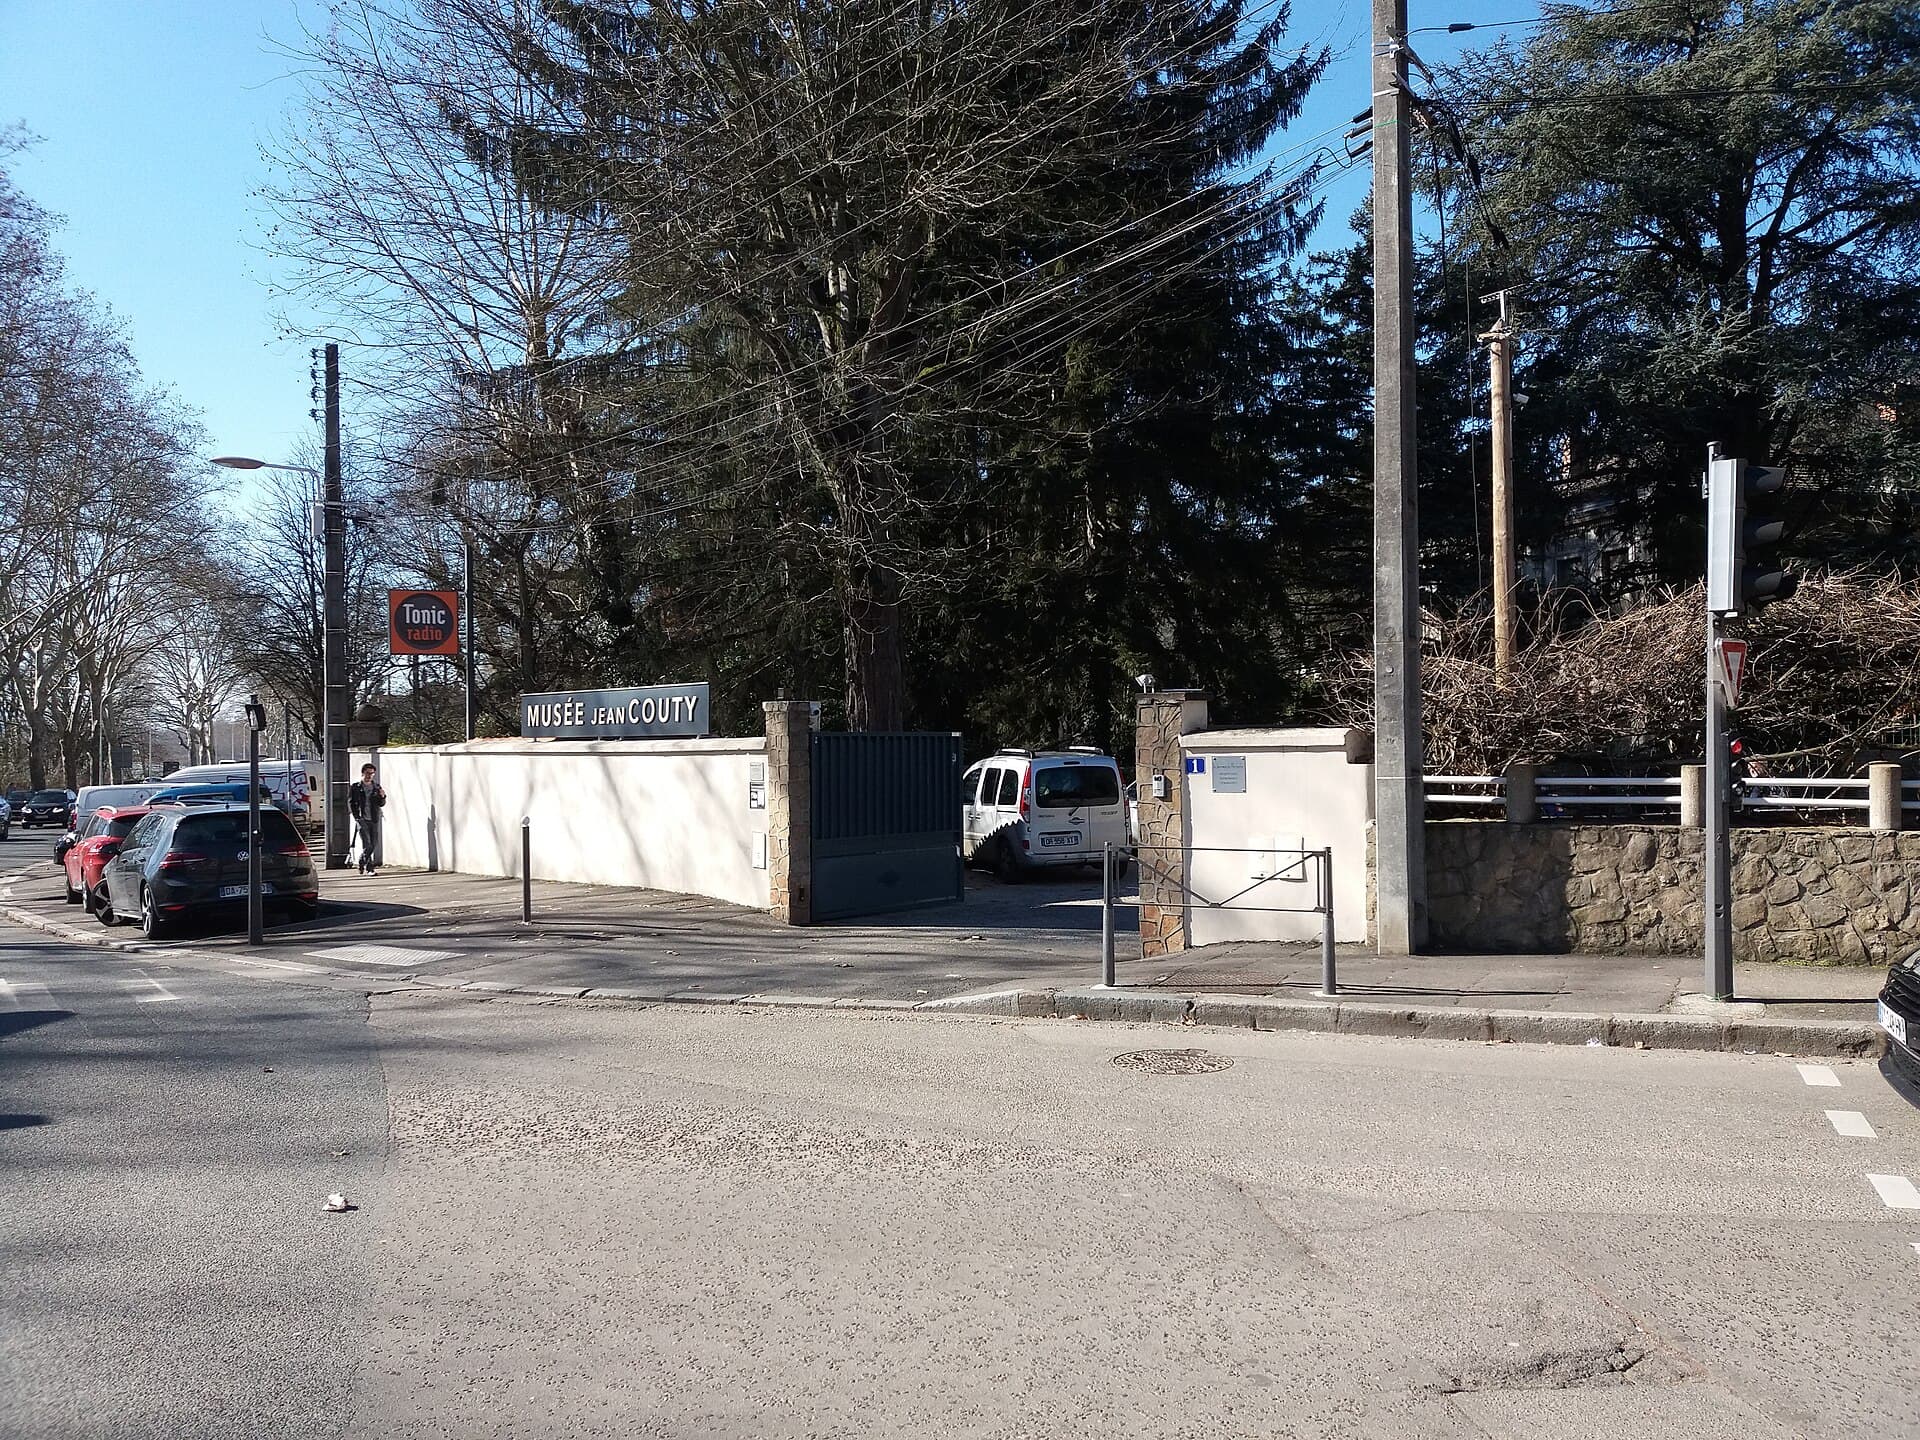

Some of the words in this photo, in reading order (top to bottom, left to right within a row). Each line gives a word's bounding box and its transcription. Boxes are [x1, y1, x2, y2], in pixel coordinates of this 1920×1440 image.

[402, 603, 446, 625] Tonic
[408, 626, 443, 641] radio
[527, 697, 584, 727] MUSÉE
[591, 706, 626, 726] JEAN
[628, 694, 698, 724] COUTY
[1191, 758, 1199, 773] 1
